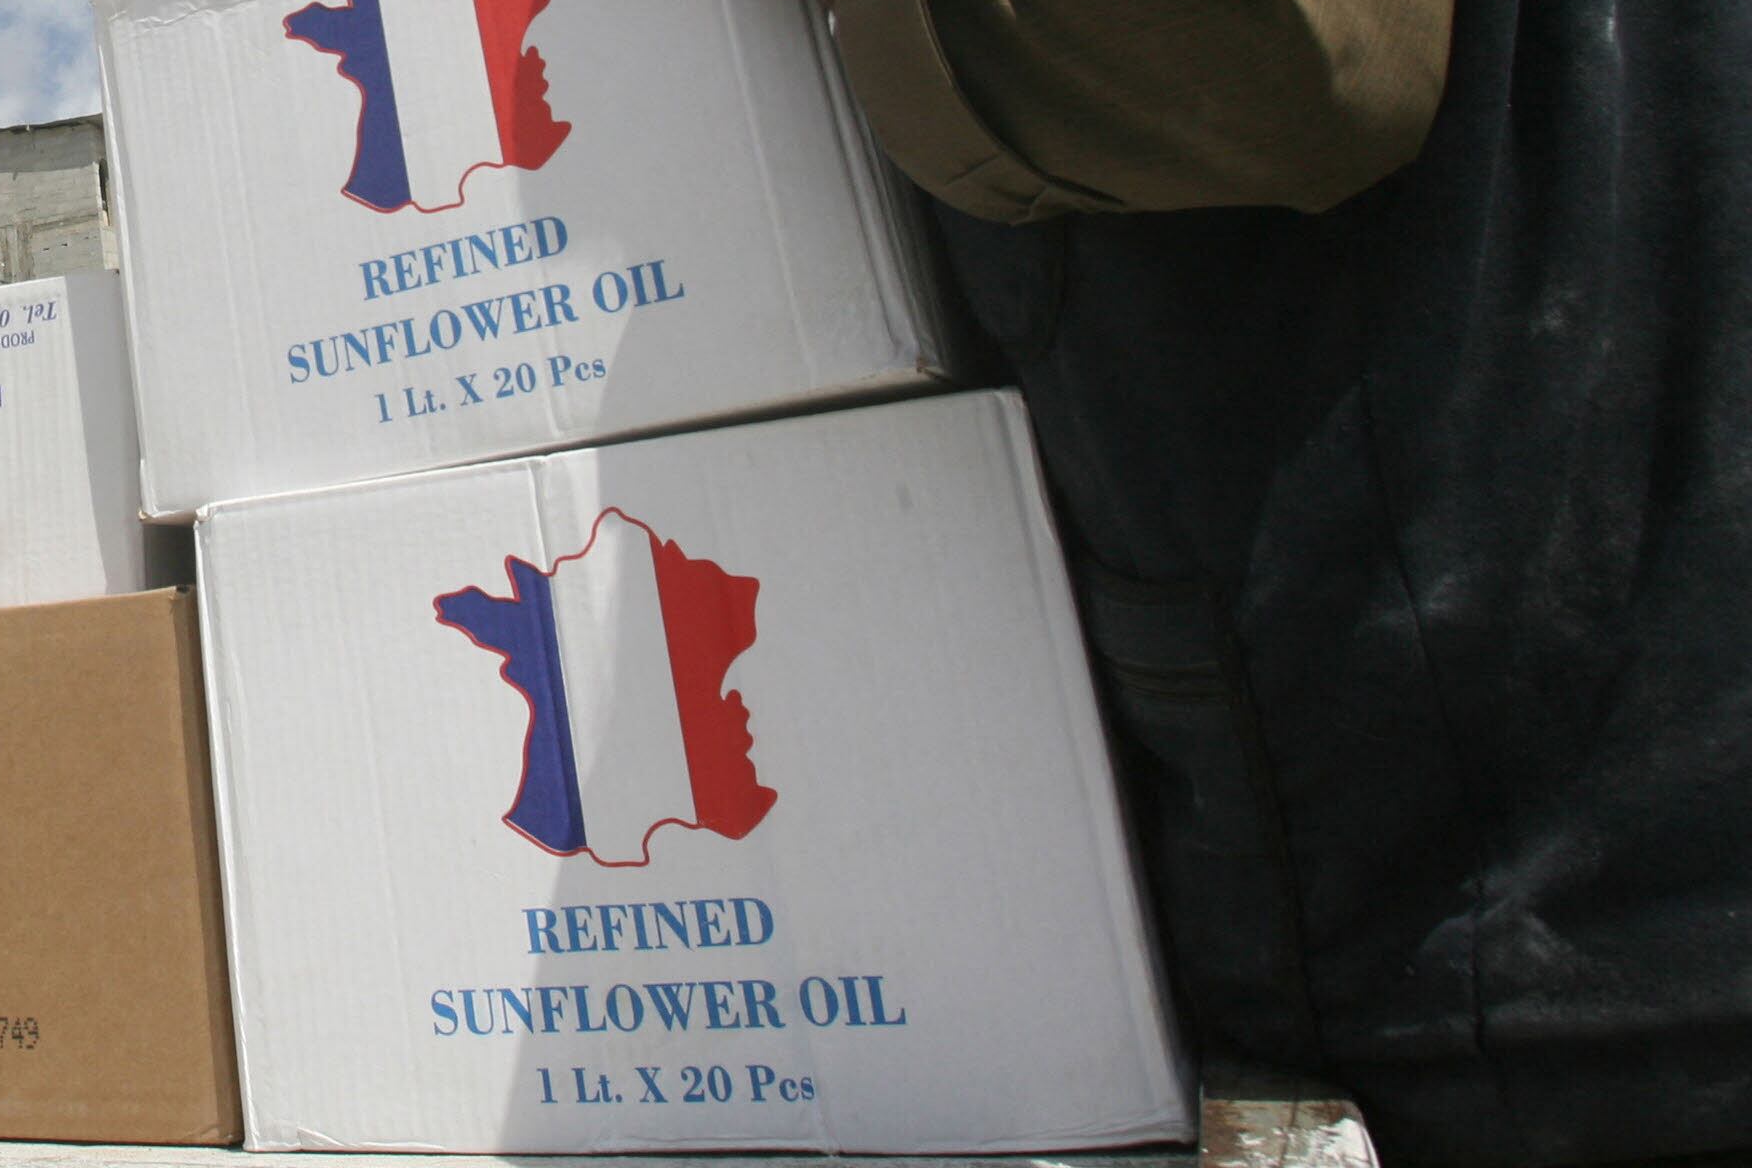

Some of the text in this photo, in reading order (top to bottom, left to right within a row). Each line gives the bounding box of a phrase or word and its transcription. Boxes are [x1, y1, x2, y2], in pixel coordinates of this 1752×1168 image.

[358, 215, 569, 301] REFINED
[22, 300, 57, 322] Tel.
[287, 259, 685, 385] SUNFLOWER OIL
[374, 354, 607, 424] 1 Lt. X 20 Pcs
[521, 896, 775, 954] REFINED
[430, 975, 907, 1037] SUNFLOWER OIL
[536, 1064, 816, 1105] 1 Lt. X 20 Pcs
